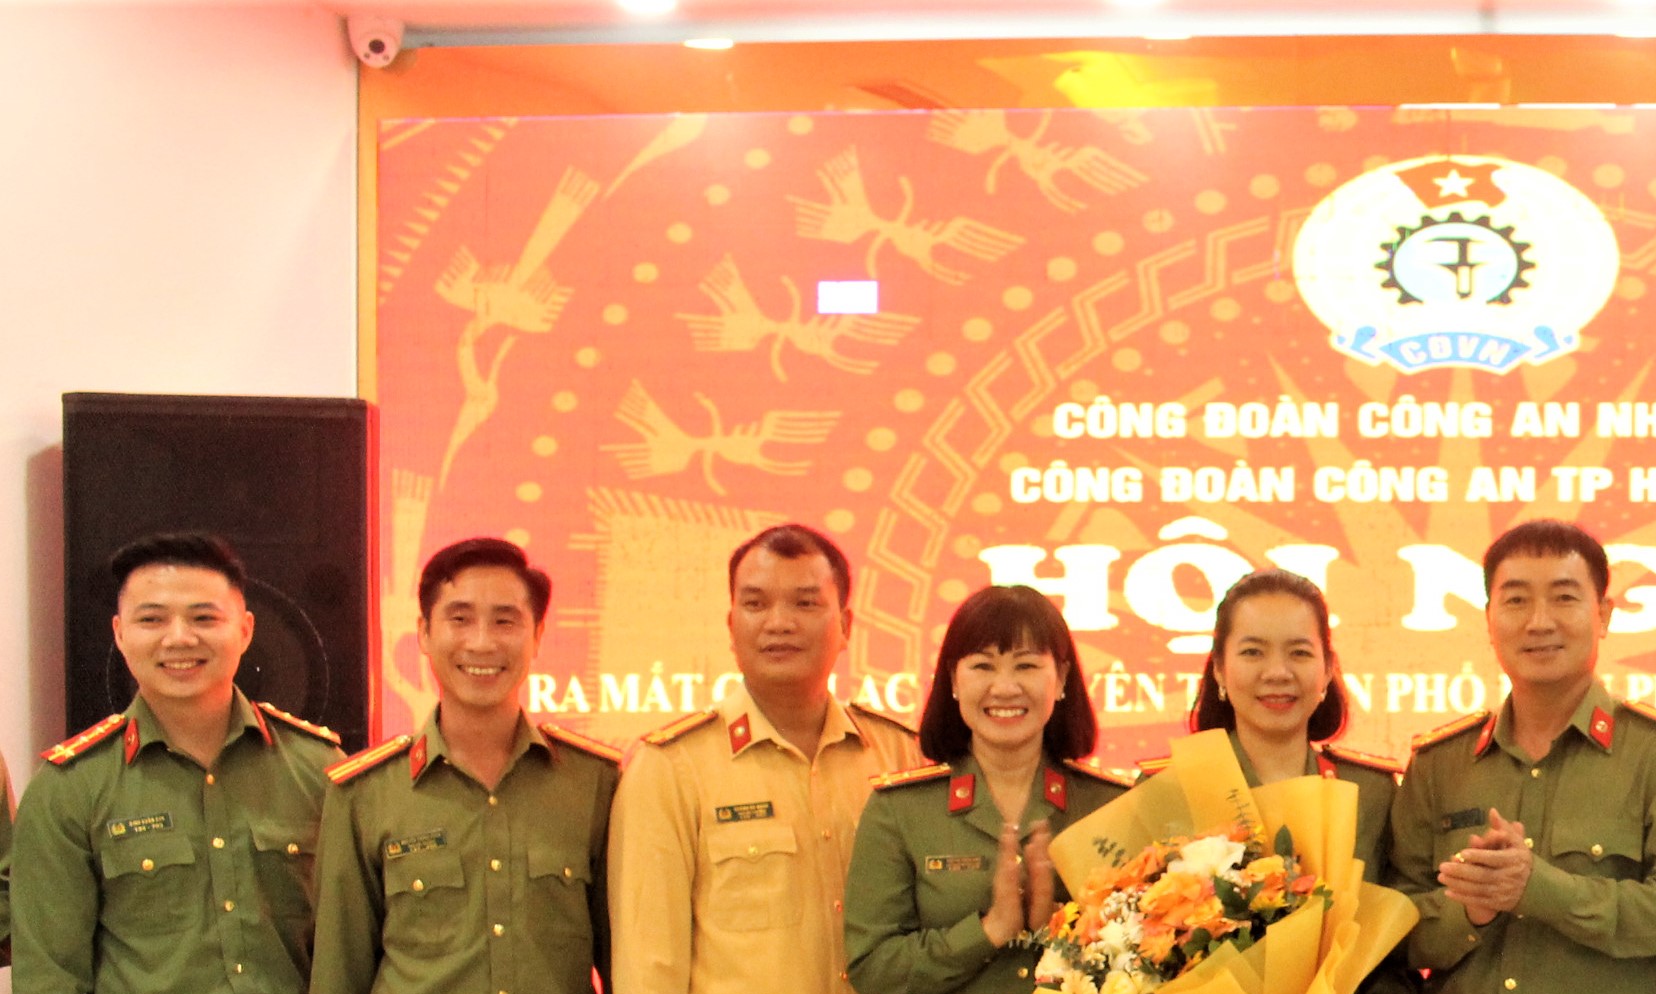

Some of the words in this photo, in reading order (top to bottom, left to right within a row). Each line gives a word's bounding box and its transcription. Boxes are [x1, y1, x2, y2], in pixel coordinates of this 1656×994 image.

[1053, 395, 1187, 438] CÔNG
[1203, 395, 1339, 438] ĐOÀN
[1358, 395, 1493, 438] CÔNG
[1511, 401, 1580, 438] AN
[1010, 460, 1143, 502] CÔNG
[1160, 460, 1295, 502] ĐOÀN
[1314, 460, 1449, 502] CÔNG
[1465, 466, 1536, 502] AN
[1551, 466, 1614, 502] TP
[528, 673, 590, 713] RA
